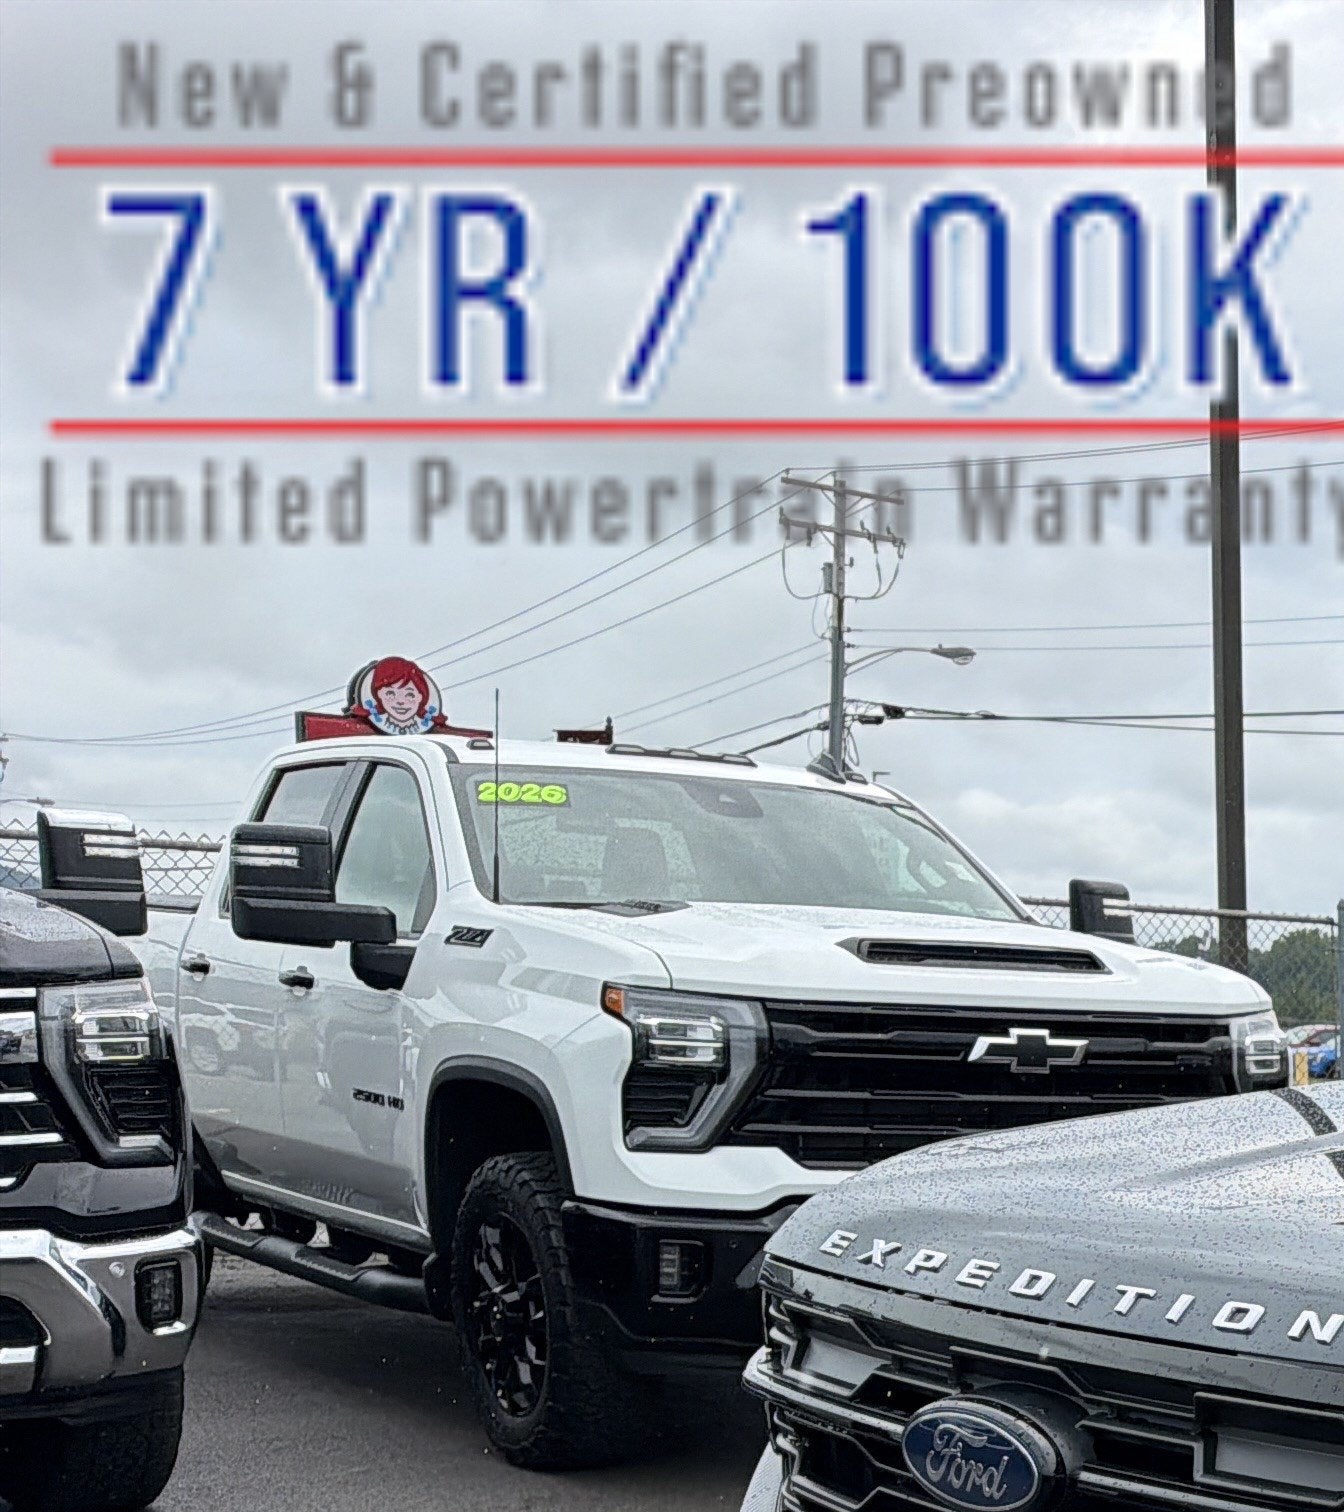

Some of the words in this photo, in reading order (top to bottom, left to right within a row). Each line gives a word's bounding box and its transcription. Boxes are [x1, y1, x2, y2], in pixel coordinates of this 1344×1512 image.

[477, 782, 568, 805] 2026
[353, 1088, 385, 1106] 2500
[925, 1422, 1010, 1501] Ford
